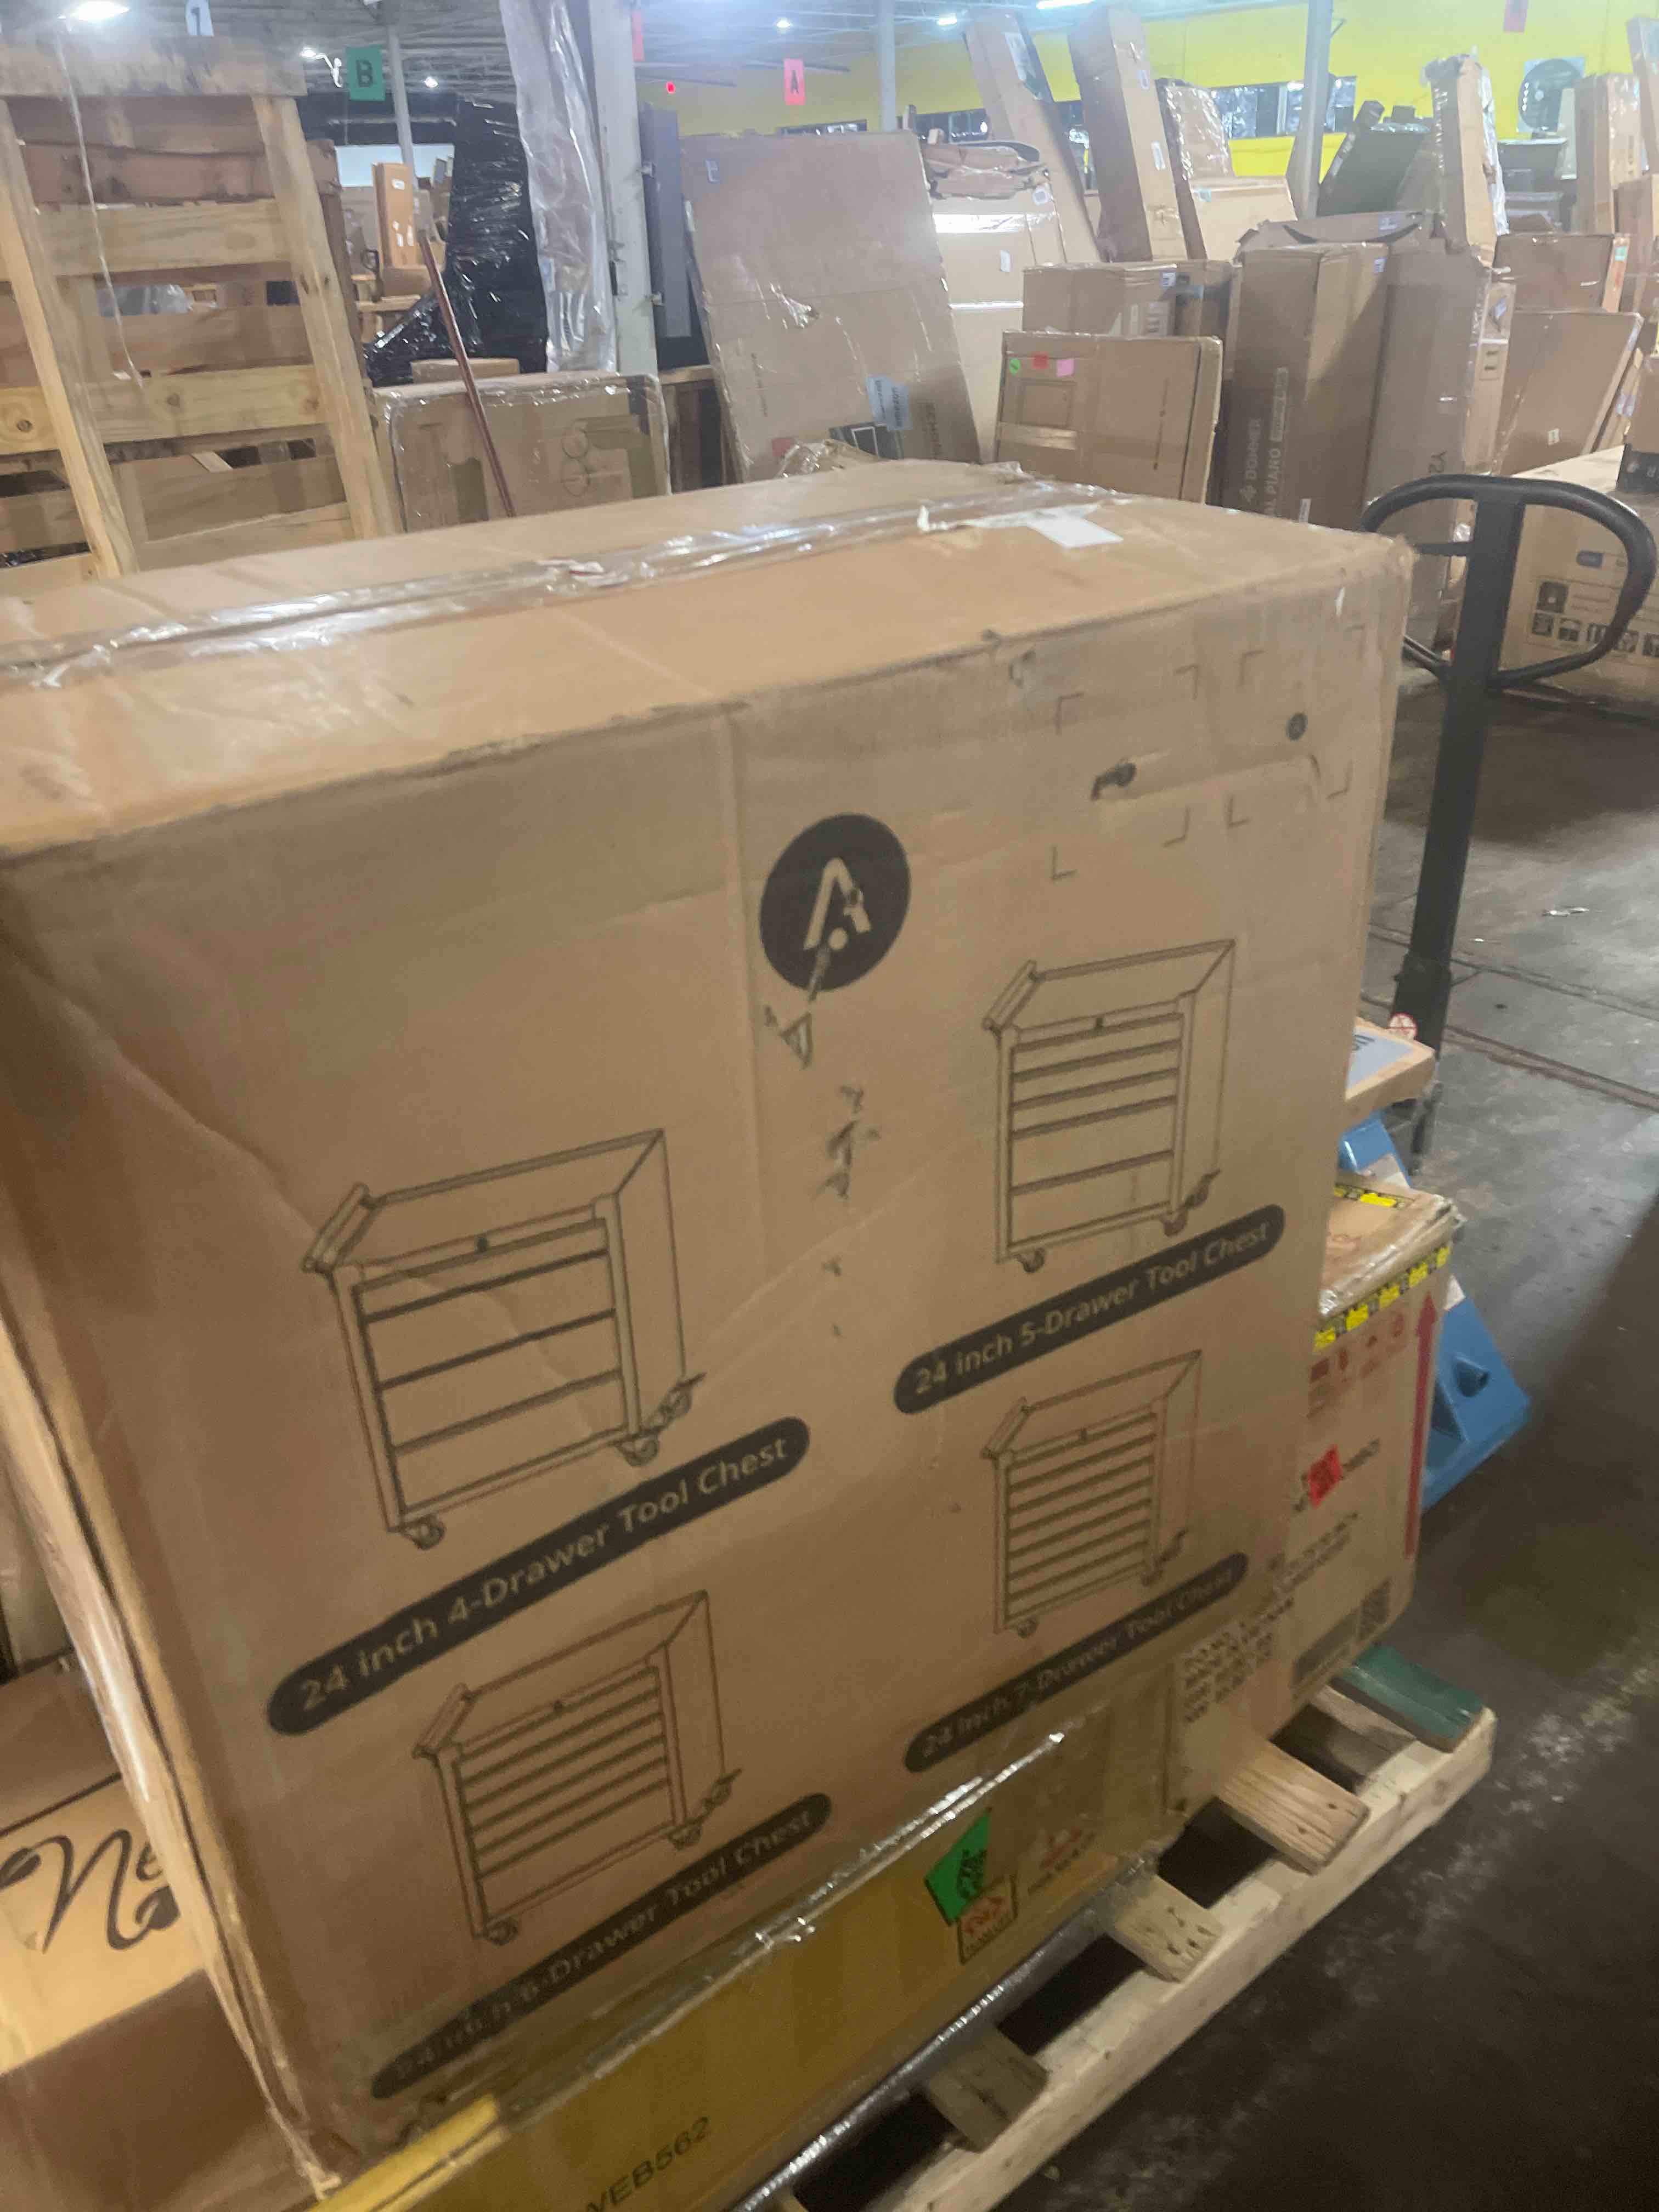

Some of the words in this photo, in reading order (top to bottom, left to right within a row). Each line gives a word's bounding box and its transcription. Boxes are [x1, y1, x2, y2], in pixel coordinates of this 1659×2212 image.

[356, 60, 373, 87] B
[790, 70, 799, 94] A
[916, 1365, 947, 1393] 24
[957, 1334, 1012, 1375] inch
[1021, 1278, 1140, 1347] 5-Drawer
[1146, 1250, 1198, 1290] Tool
[1204, 1222, 1269, 1266] Chest
[297, 1662, 349, 1713] 24
[357, 1613, 437, 1680] inch
[446, 1520, 610, 1626] 4-Drawer
[618, 1483, 689, 1535] Tool
[697, 1436, 788, 1497] Chest
[665, 1855, 729, 1908] Tool
[733, 1809, 811, 1866] Chest
